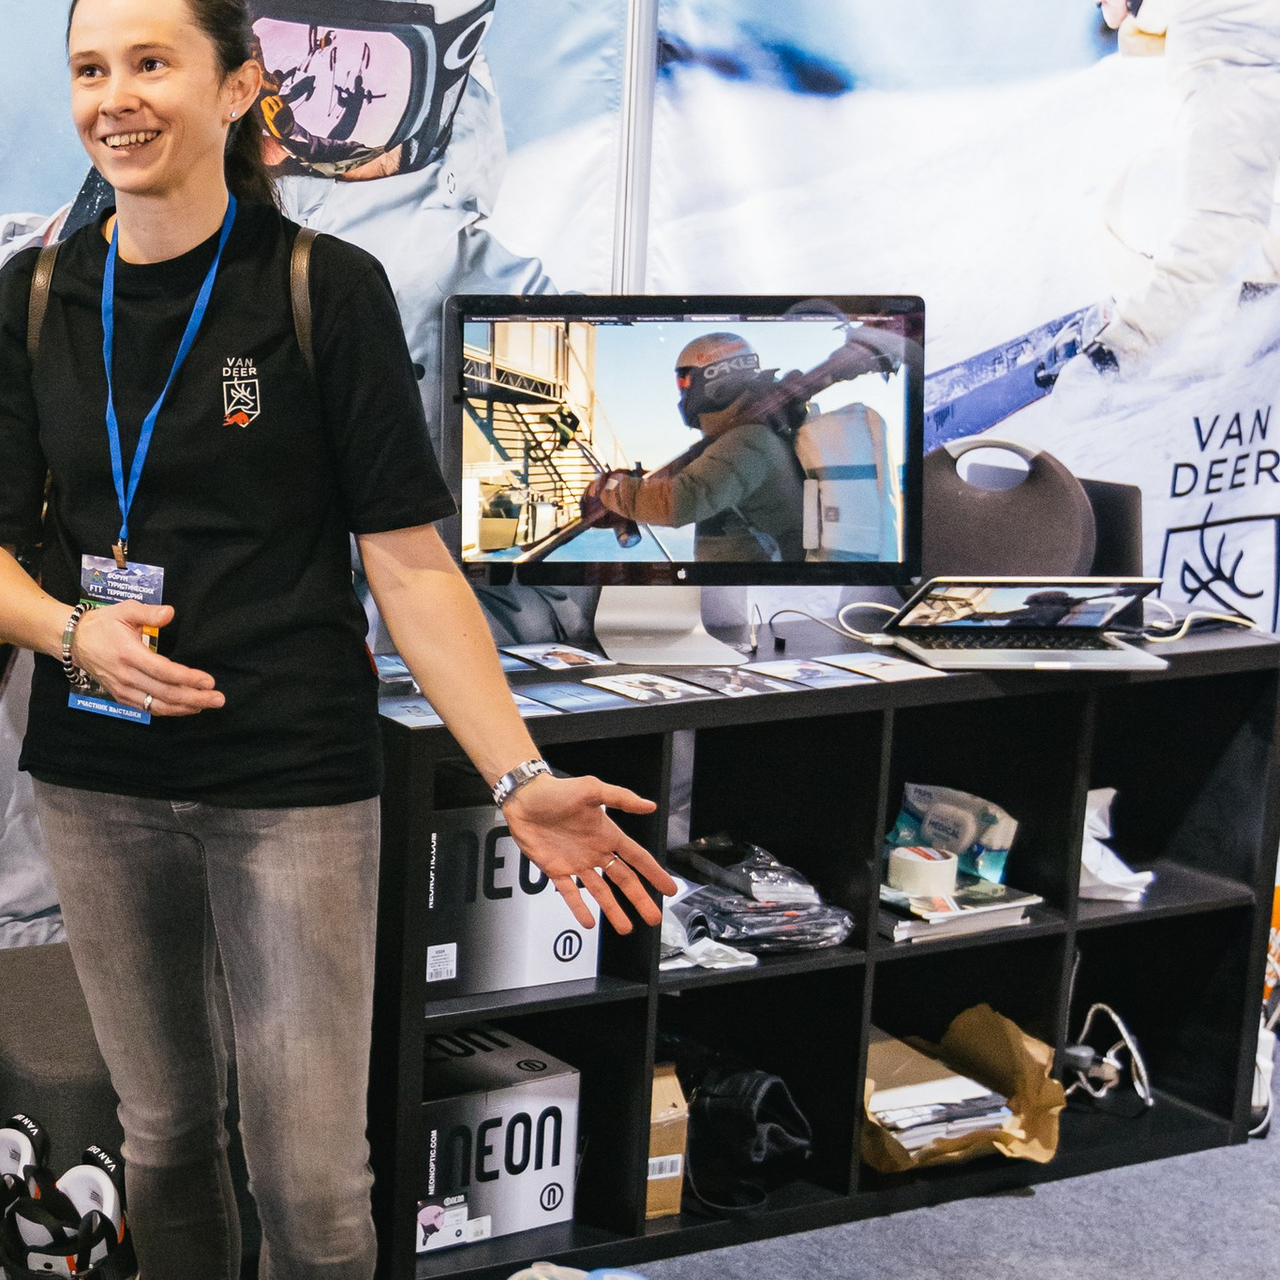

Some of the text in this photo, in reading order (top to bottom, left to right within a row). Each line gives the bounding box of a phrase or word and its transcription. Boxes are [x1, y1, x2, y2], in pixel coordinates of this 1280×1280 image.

[222, 367, 257, 377] DEER
[226, 357, 253, 367] VAN
[1193, 405, 1272, 453] VAN
[1170, 449, 1280, 498] DEER
[89, 584, 103, 594] FTT
[77, 699, 142, 720] УЧАСТНИК ВЫСТАВКИ
[98, 1151, 117, 1173] VAN
[428, 1129, 438, 1196] NEONOPTIC.COM
